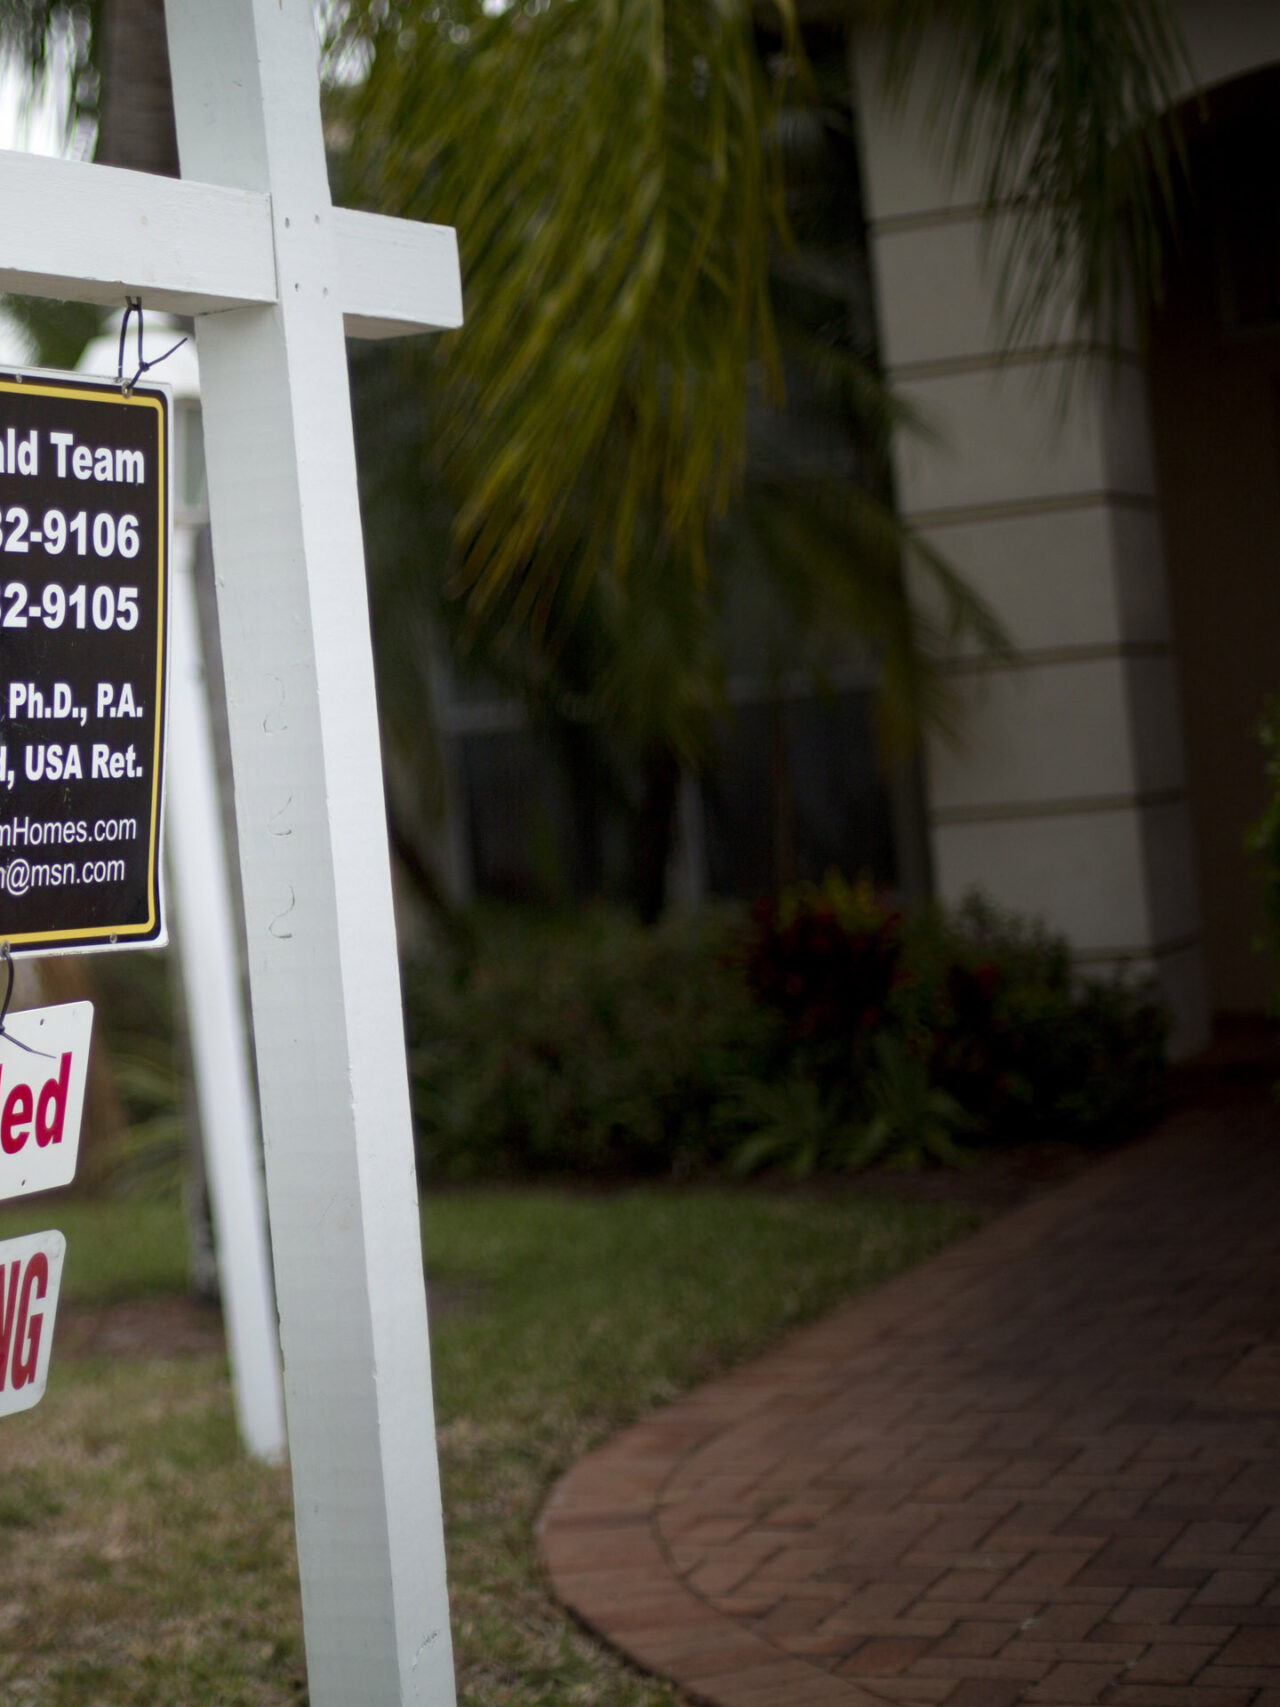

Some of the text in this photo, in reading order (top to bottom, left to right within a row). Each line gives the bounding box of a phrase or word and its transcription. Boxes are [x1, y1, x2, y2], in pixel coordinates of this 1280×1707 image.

[50, 432, 145, 483] Team
[9, 682, 87, 725] Ph.D.,
[96, 683, 144, 718] P.A.
[25, 745, 82, 781] USA
[91, 743, 143, 778] Ret.
